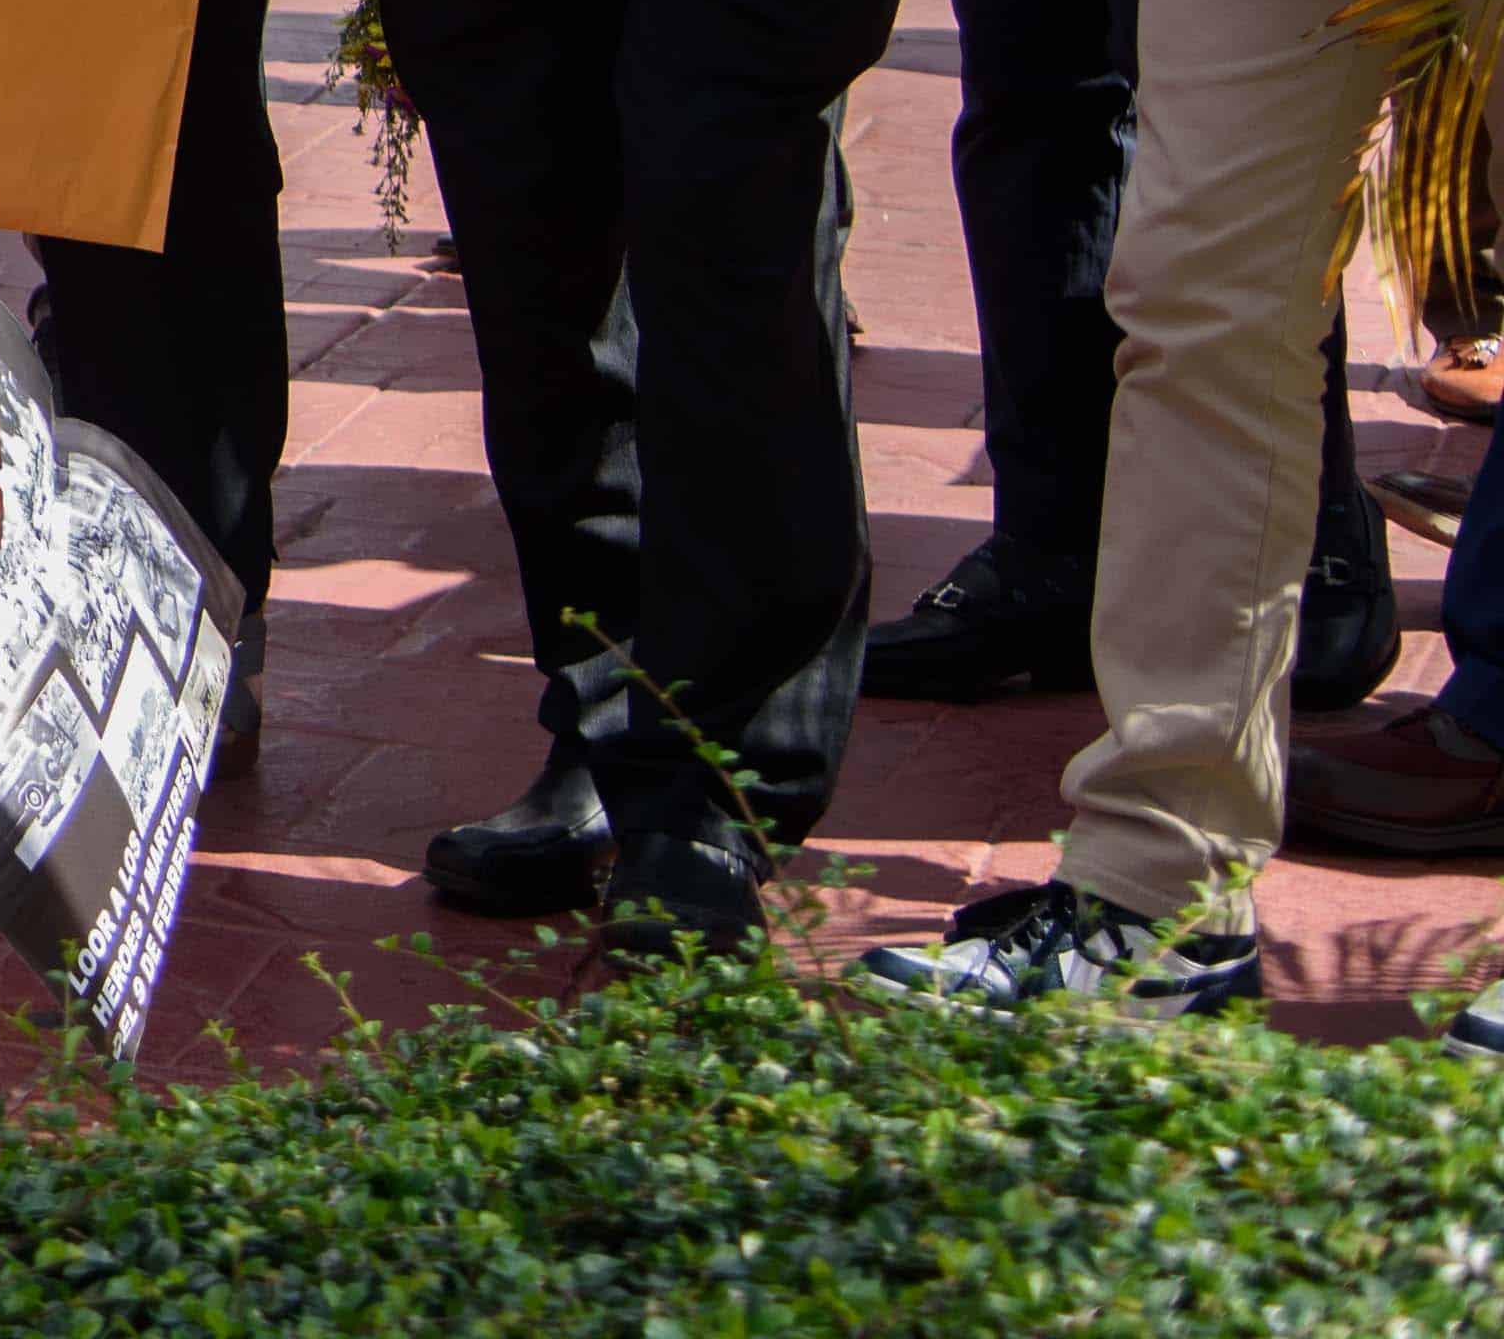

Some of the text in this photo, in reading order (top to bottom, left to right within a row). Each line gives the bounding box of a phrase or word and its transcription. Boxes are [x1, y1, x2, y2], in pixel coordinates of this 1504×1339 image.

[68, 829, 142, 995] LOOR A LOS
[92, 755, 193, 1027] HEROES Y MARTIRES
[132, 975, 147, 1005] 9
[139, 932, 163, 983] DE
